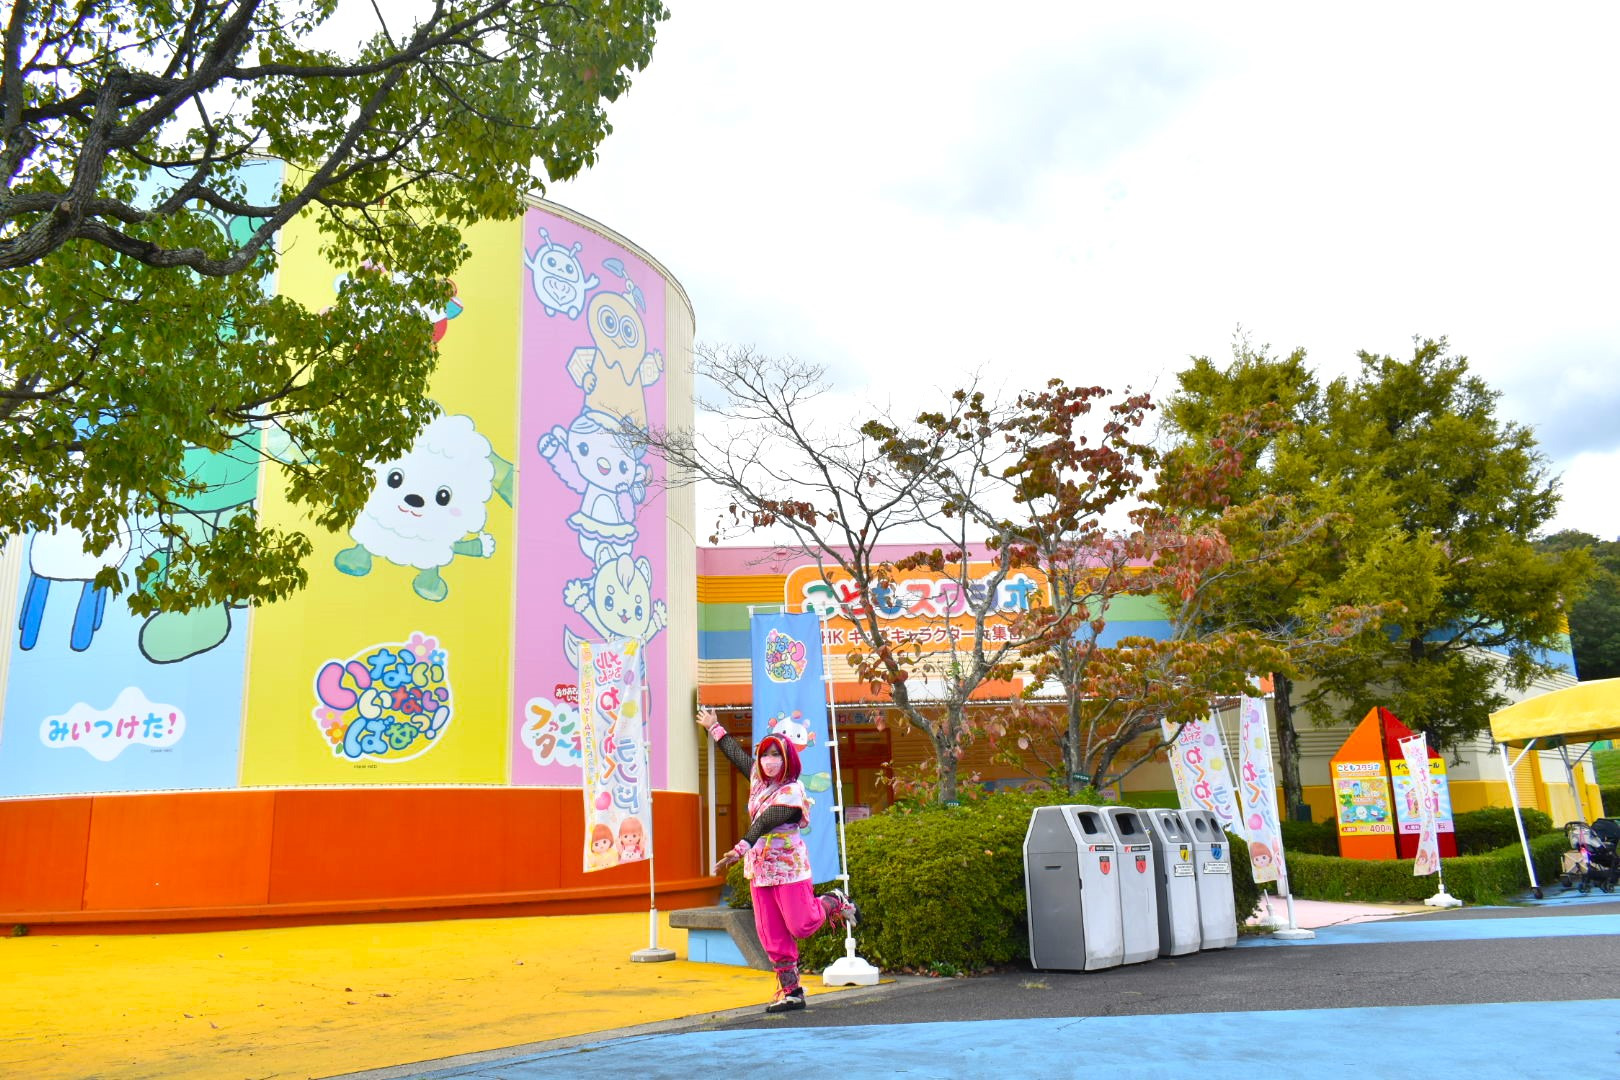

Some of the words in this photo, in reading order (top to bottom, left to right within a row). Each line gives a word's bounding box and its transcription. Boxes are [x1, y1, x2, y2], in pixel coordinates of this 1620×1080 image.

[807, 577, 1036, 615] こどもスタジオ
[820, 630, 843, 645] HK
[358, 685, 449, 720] いない
[48, 712, 177, 741] みいつけた!
[530, 704, 575, 735] ファン
[1338, 763, 1380, 772] こどもスタジオ
